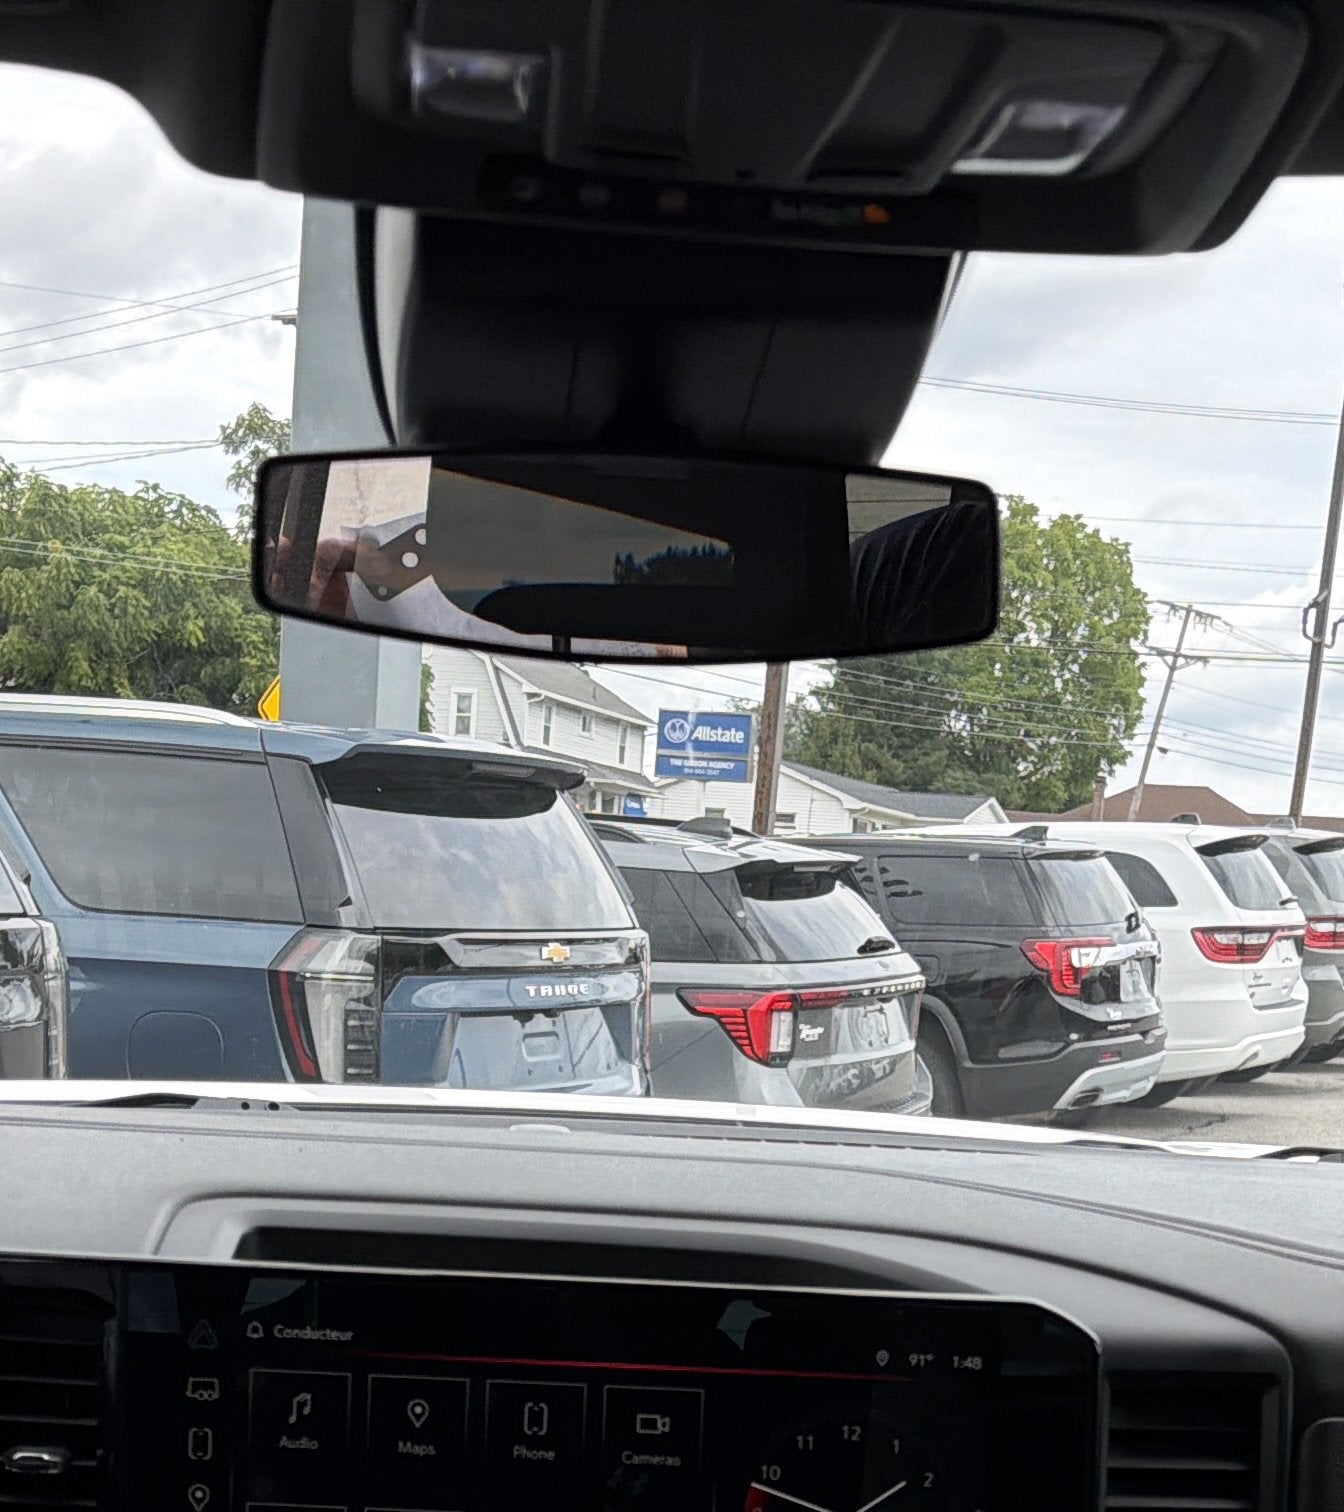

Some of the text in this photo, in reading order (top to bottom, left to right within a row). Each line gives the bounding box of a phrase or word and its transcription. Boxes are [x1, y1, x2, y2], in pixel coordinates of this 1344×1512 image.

[691, 726, 745, 743] Allstate
[525, 984, 589, 997] TAHOE
[273, 1324, 353, 1340] Conducteur
[842, 1425, 862, 1441] 12
[279, 1435, 319, 1450] Audio
[398, 1441, 437, 1456] Maps
[797, 1435, 814, 1450] 11
[893, 1438, 900, 1455] 1
[513, 1445, 556, 1461] Phone
[622, 1451, 681, 1467] Cameras
[760, 1464, 781, 1481] 10
[923, 1472, 934, 1488] 2
